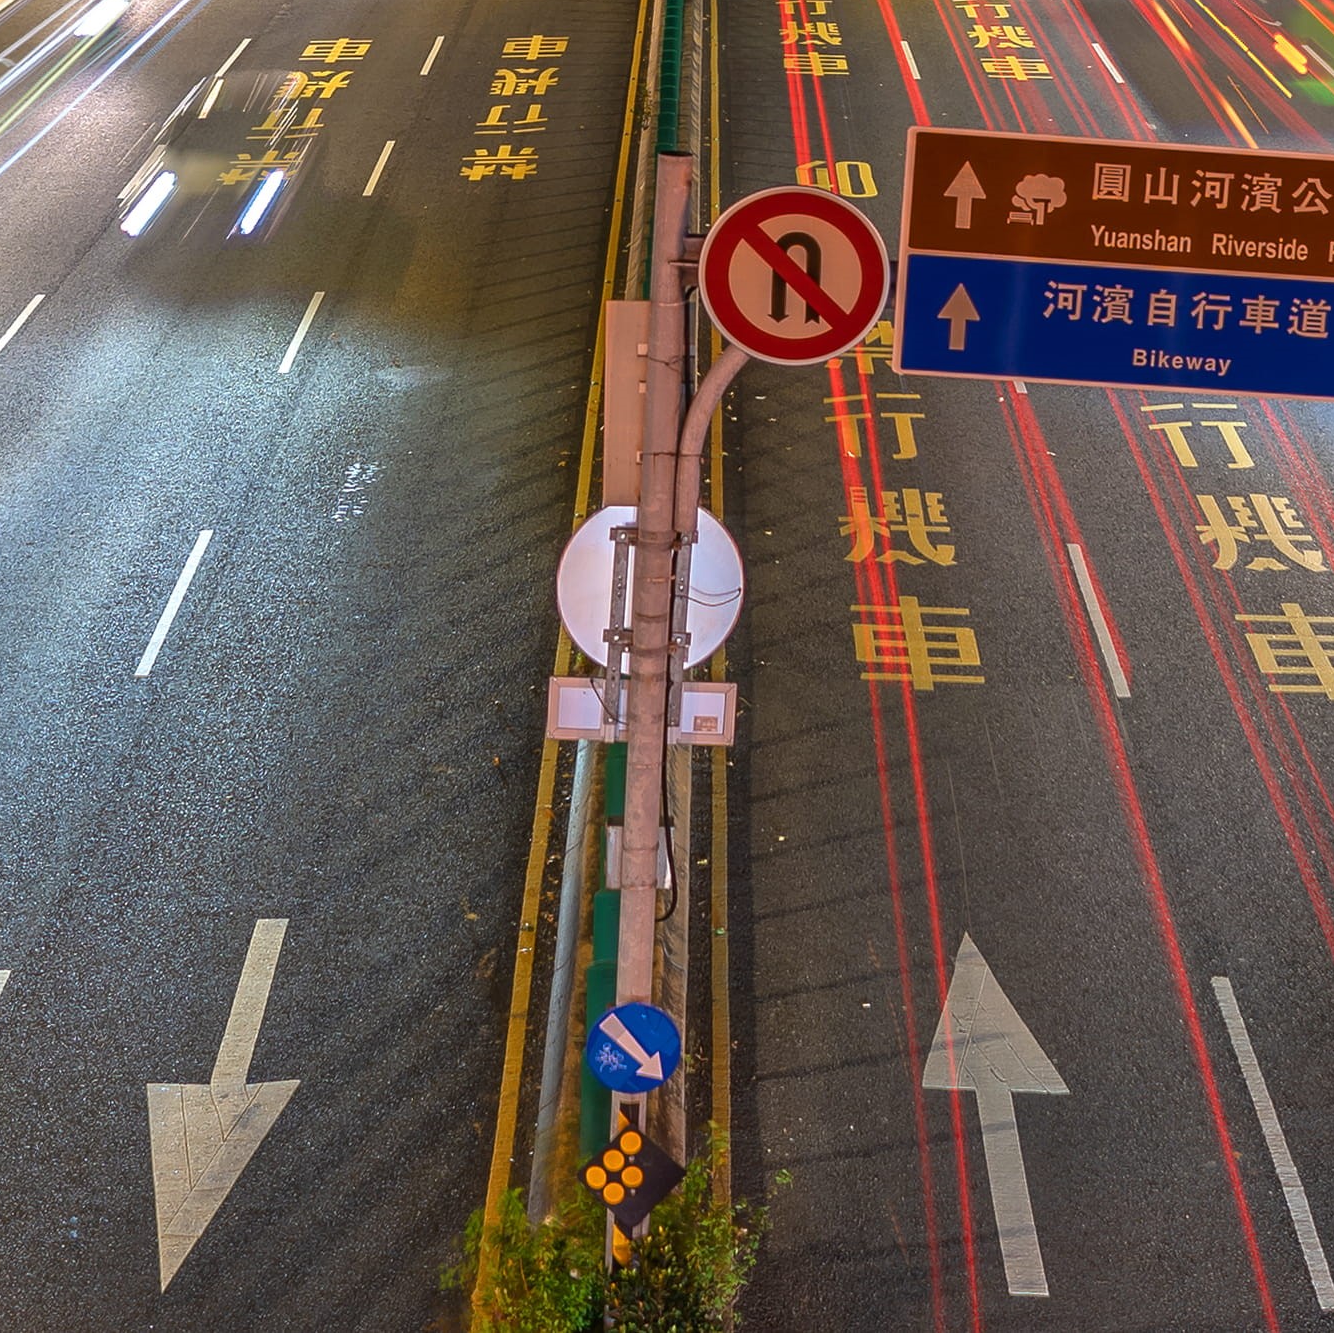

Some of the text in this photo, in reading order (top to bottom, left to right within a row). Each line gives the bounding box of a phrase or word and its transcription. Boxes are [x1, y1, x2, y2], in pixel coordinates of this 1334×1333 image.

[217, 37, 373, 186] 禁行機車
[459, 34, 570, 182] 禁行機車
[1091, 225, 1192, 254] Yuanshan
[1211, 233, 1309, 261] Riverside
[1043, 280, 1331, 339] 河濱自行車道
[1133, 349, 1232, 376] Bikeway
